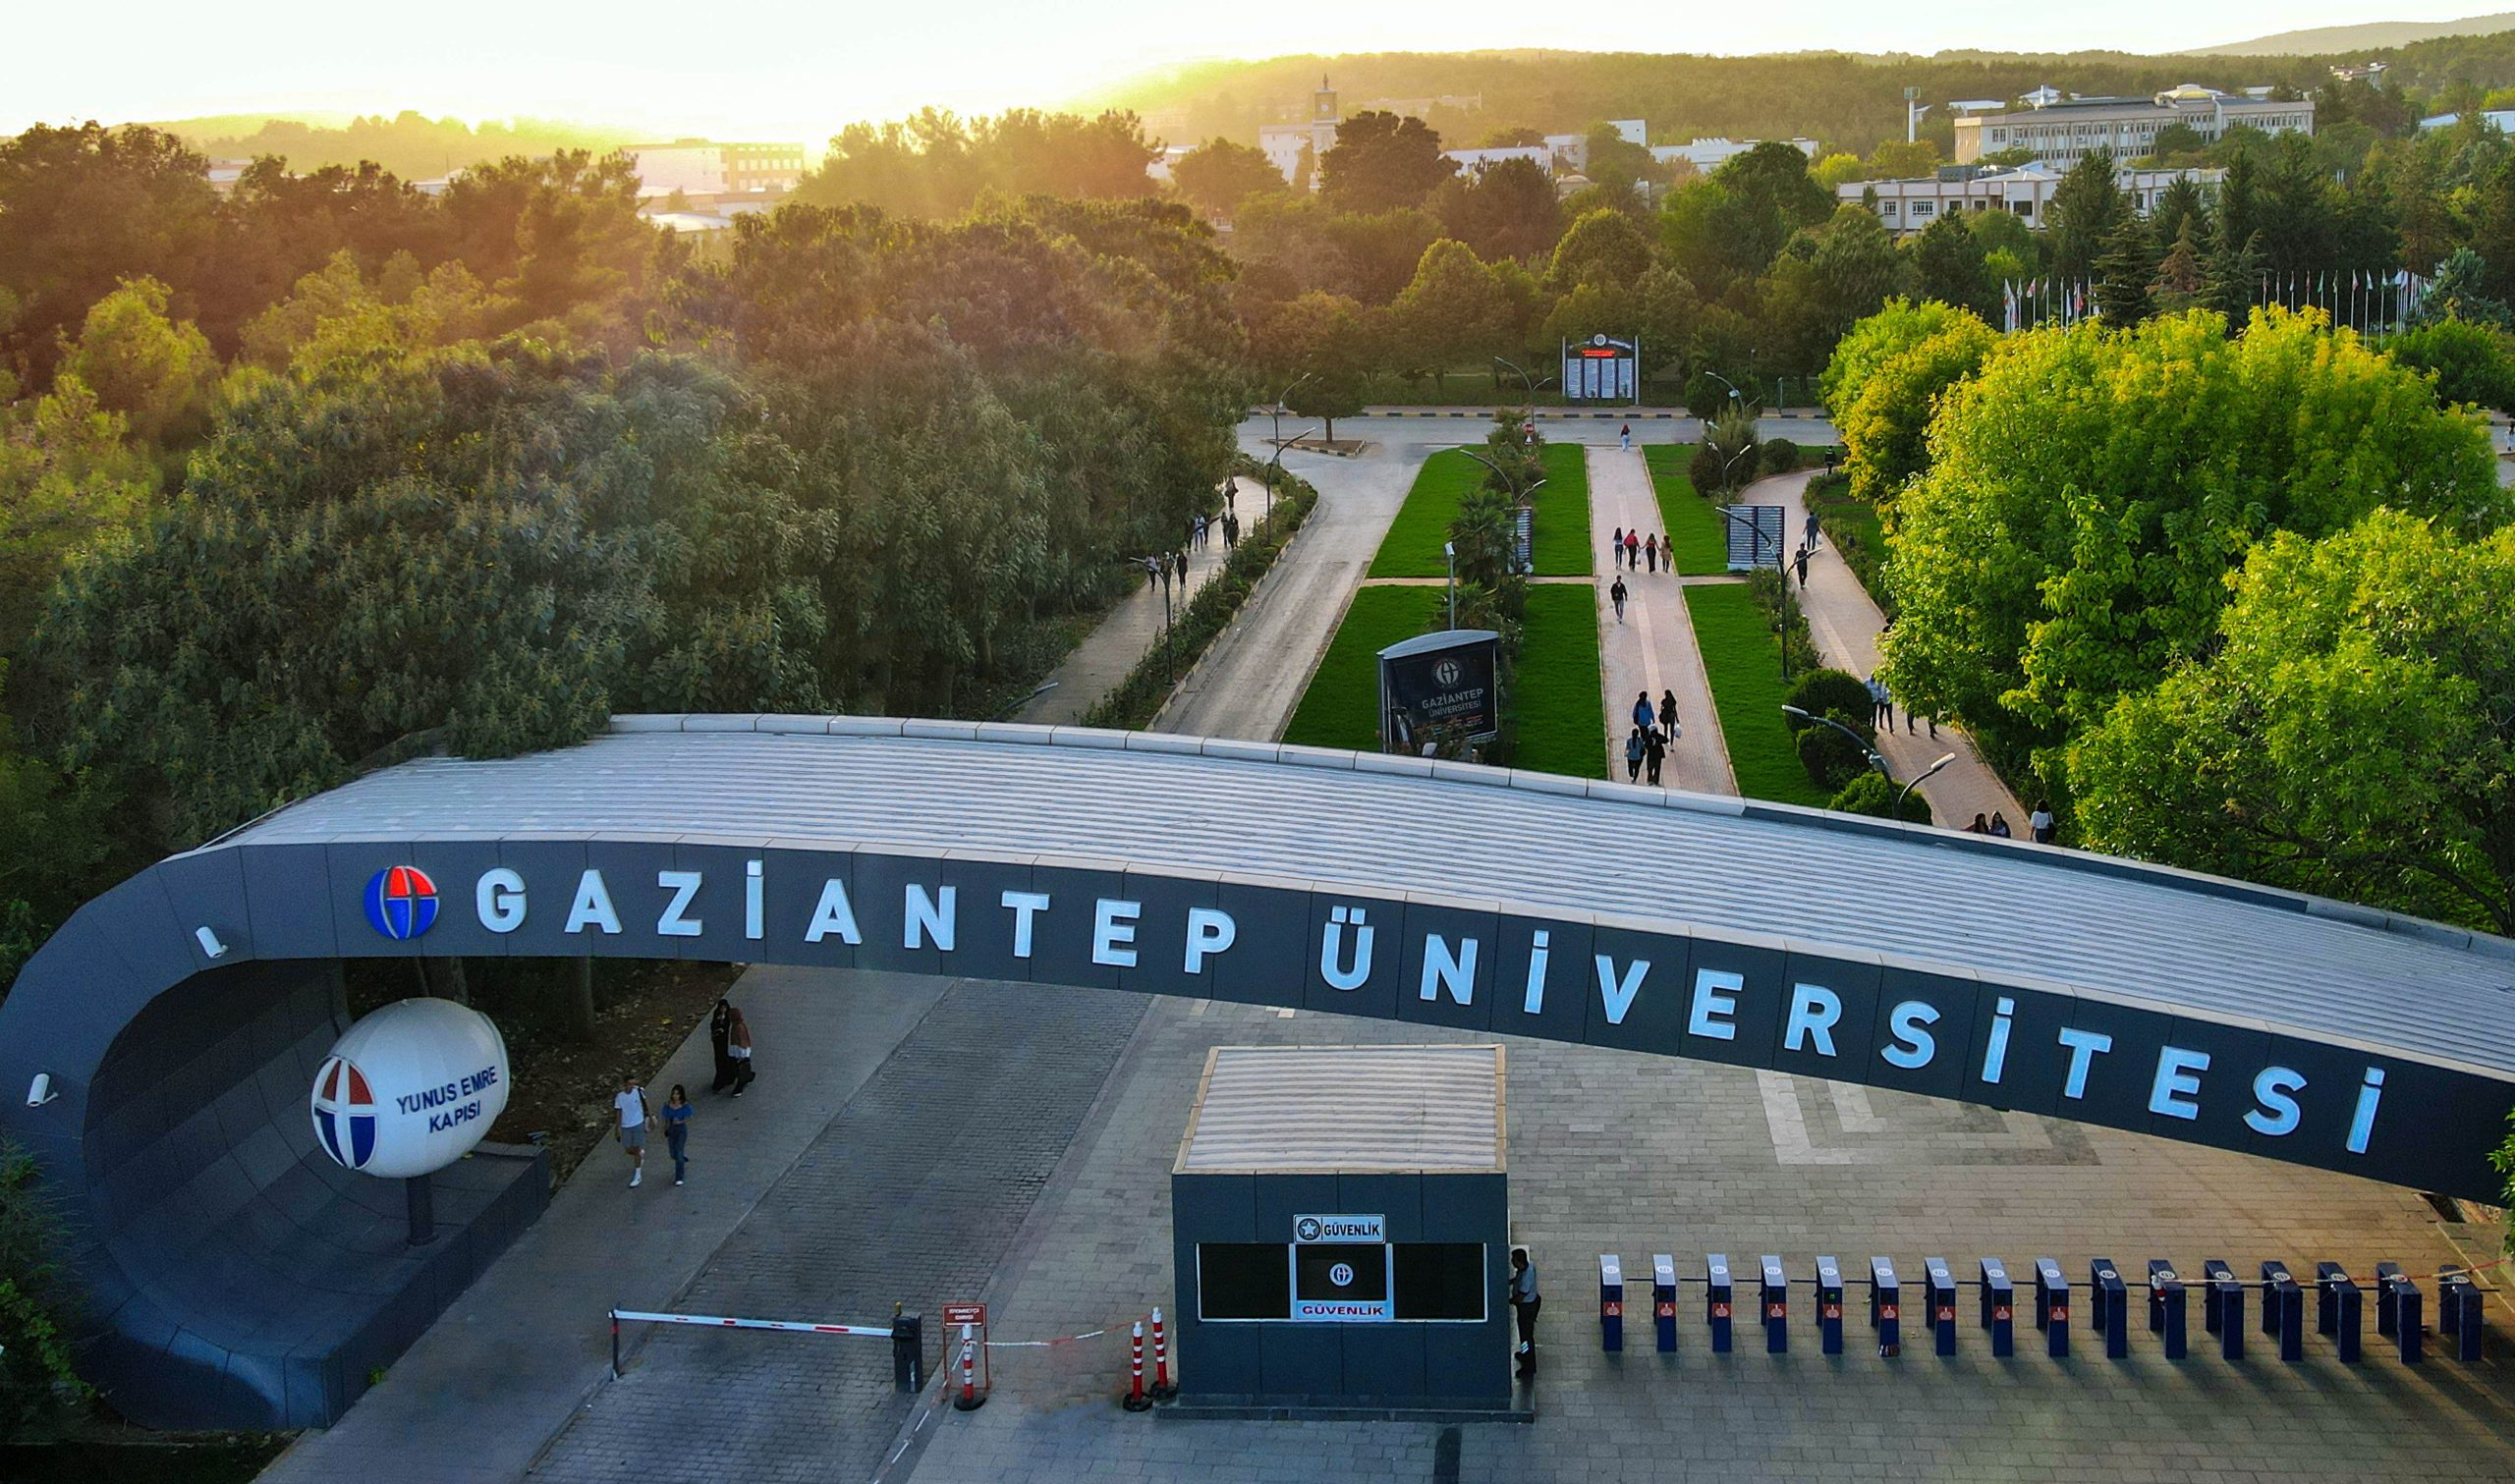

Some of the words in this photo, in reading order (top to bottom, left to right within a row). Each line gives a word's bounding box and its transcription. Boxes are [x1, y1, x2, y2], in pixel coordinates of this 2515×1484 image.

[1422, 687, 1483, 709] GAZİANTEP
[1428, 699, 1481, 718] ÜNİVERSİTESİ
[475, 859, 1237, 974] GAZİANTEP
[1319, 906, 2386, 1155] ÜNİVERSİTESİ
[396, 1083, 458, 1115] YUNUS
[461, 1066, 498, 1096] EMRE
[429, 1100, 480, 1133] KAPISI
[1323, 1222, 1380, 1237] GÜVENLİK
[1302, 1304, 1383, 1316] GÜVENLİK
